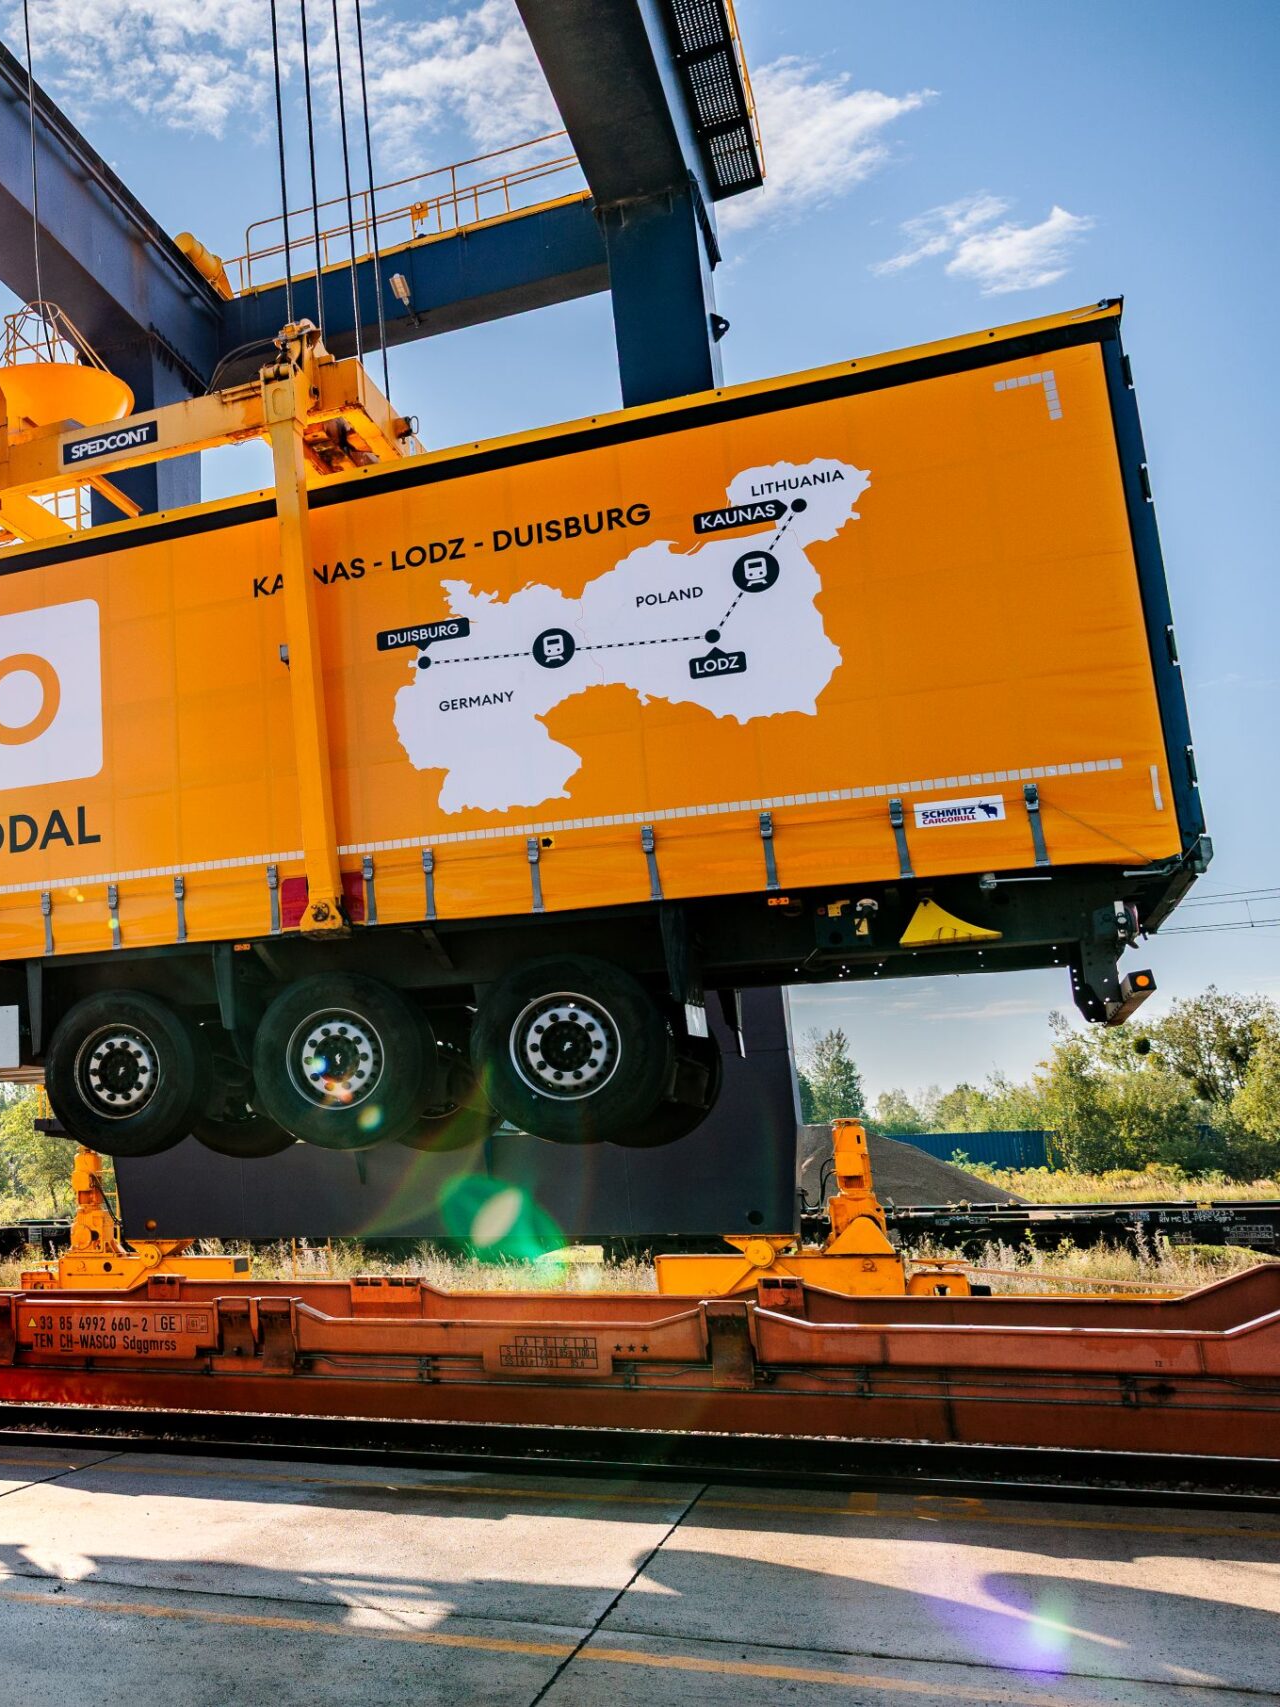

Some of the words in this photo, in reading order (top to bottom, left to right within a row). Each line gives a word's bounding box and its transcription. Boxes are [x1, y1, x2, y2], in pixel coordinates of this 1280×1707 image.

[71, 426, 150, 459] SPEDCONT
[751, 469, 845, 497] LITHUANIA
[700, 504, 776, 530] KAUNAS
[253, 557, 366, 598] KANAS
[391, 537, 467, 572] LODZ
[492, 502, 652, 553] DUISBURG
[635, 586, 704, 608] POLAND
[387, 623, 460, 646] DUISBURG
[695, 655, 740, 674] LODZ
[439, 690, 515, 712] GERMANY
[921, 807, 976, 820] SCHMITZ
[922, 814, 977, 825] CARGOBULL
[40, 1316, 53, 1331] 33
[59, 1316, 73, 1331] 85
[78, 1316, 106, 1332] 4992
[160, 1316, 177, 1331] GE
[34, 1333, 54, 1348] TEN
[60, 1334, 117, 1350] CH-WASCO
[123, 1335, 177, 1354] Sdggmrss
